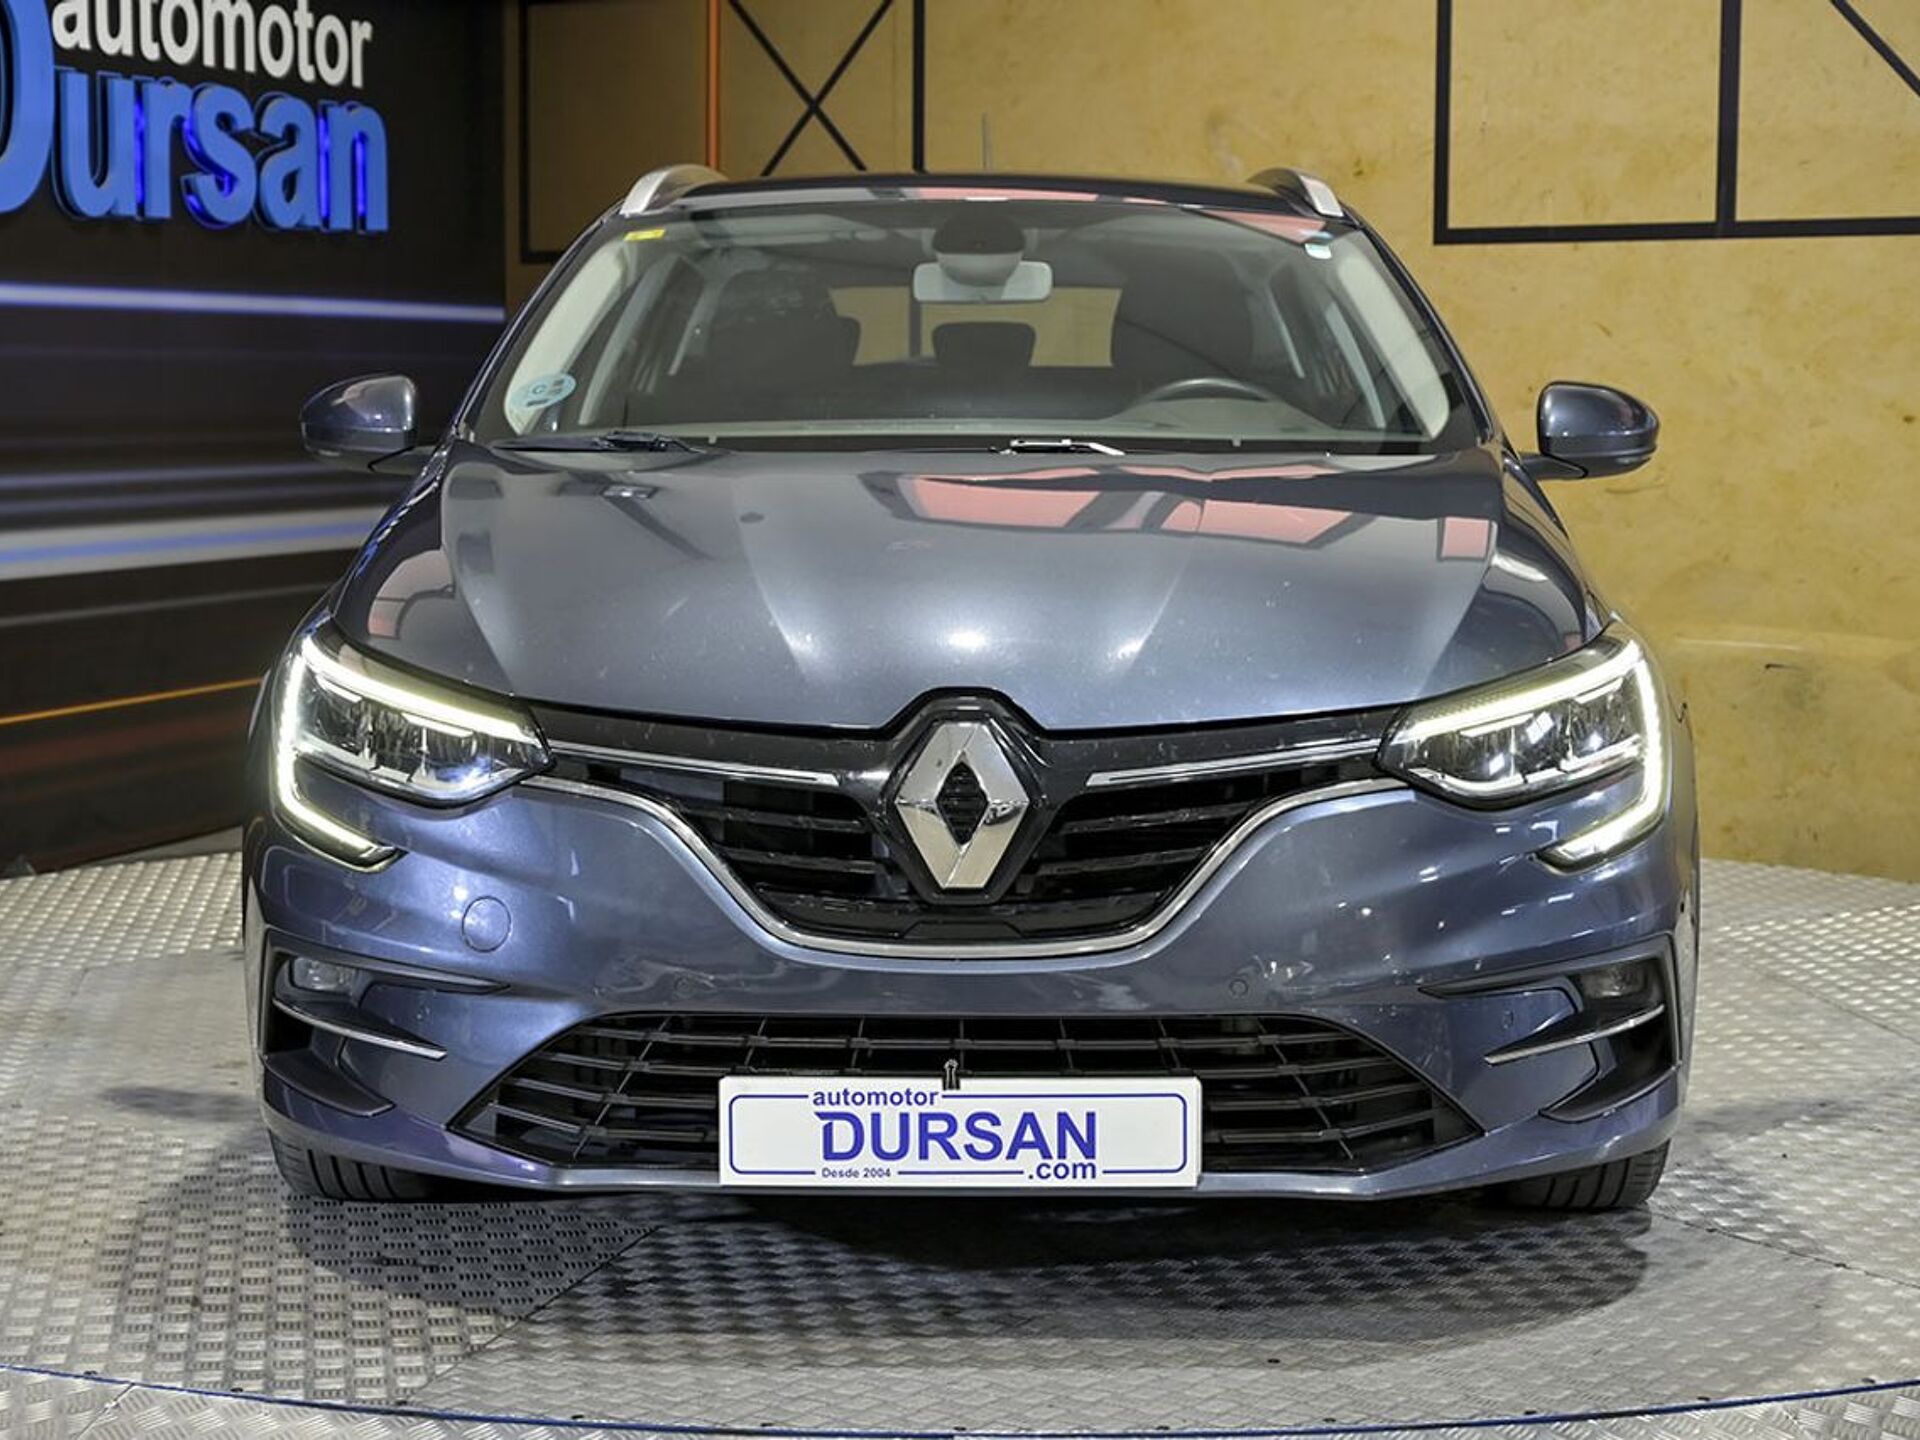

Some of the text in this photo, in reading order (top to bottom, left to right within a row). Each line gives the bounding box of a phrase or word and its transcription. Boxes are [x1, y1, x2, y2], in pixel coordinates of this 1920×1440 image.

[51, 0, 373, 88] automotor
[812, 1088, 939, 1107] automotor
[814, 1111, 1097, 1161] DURSAN
[821, 1167, 891, 1178] Desde 2004
[1028, 1161, 1097, 1180] .com
